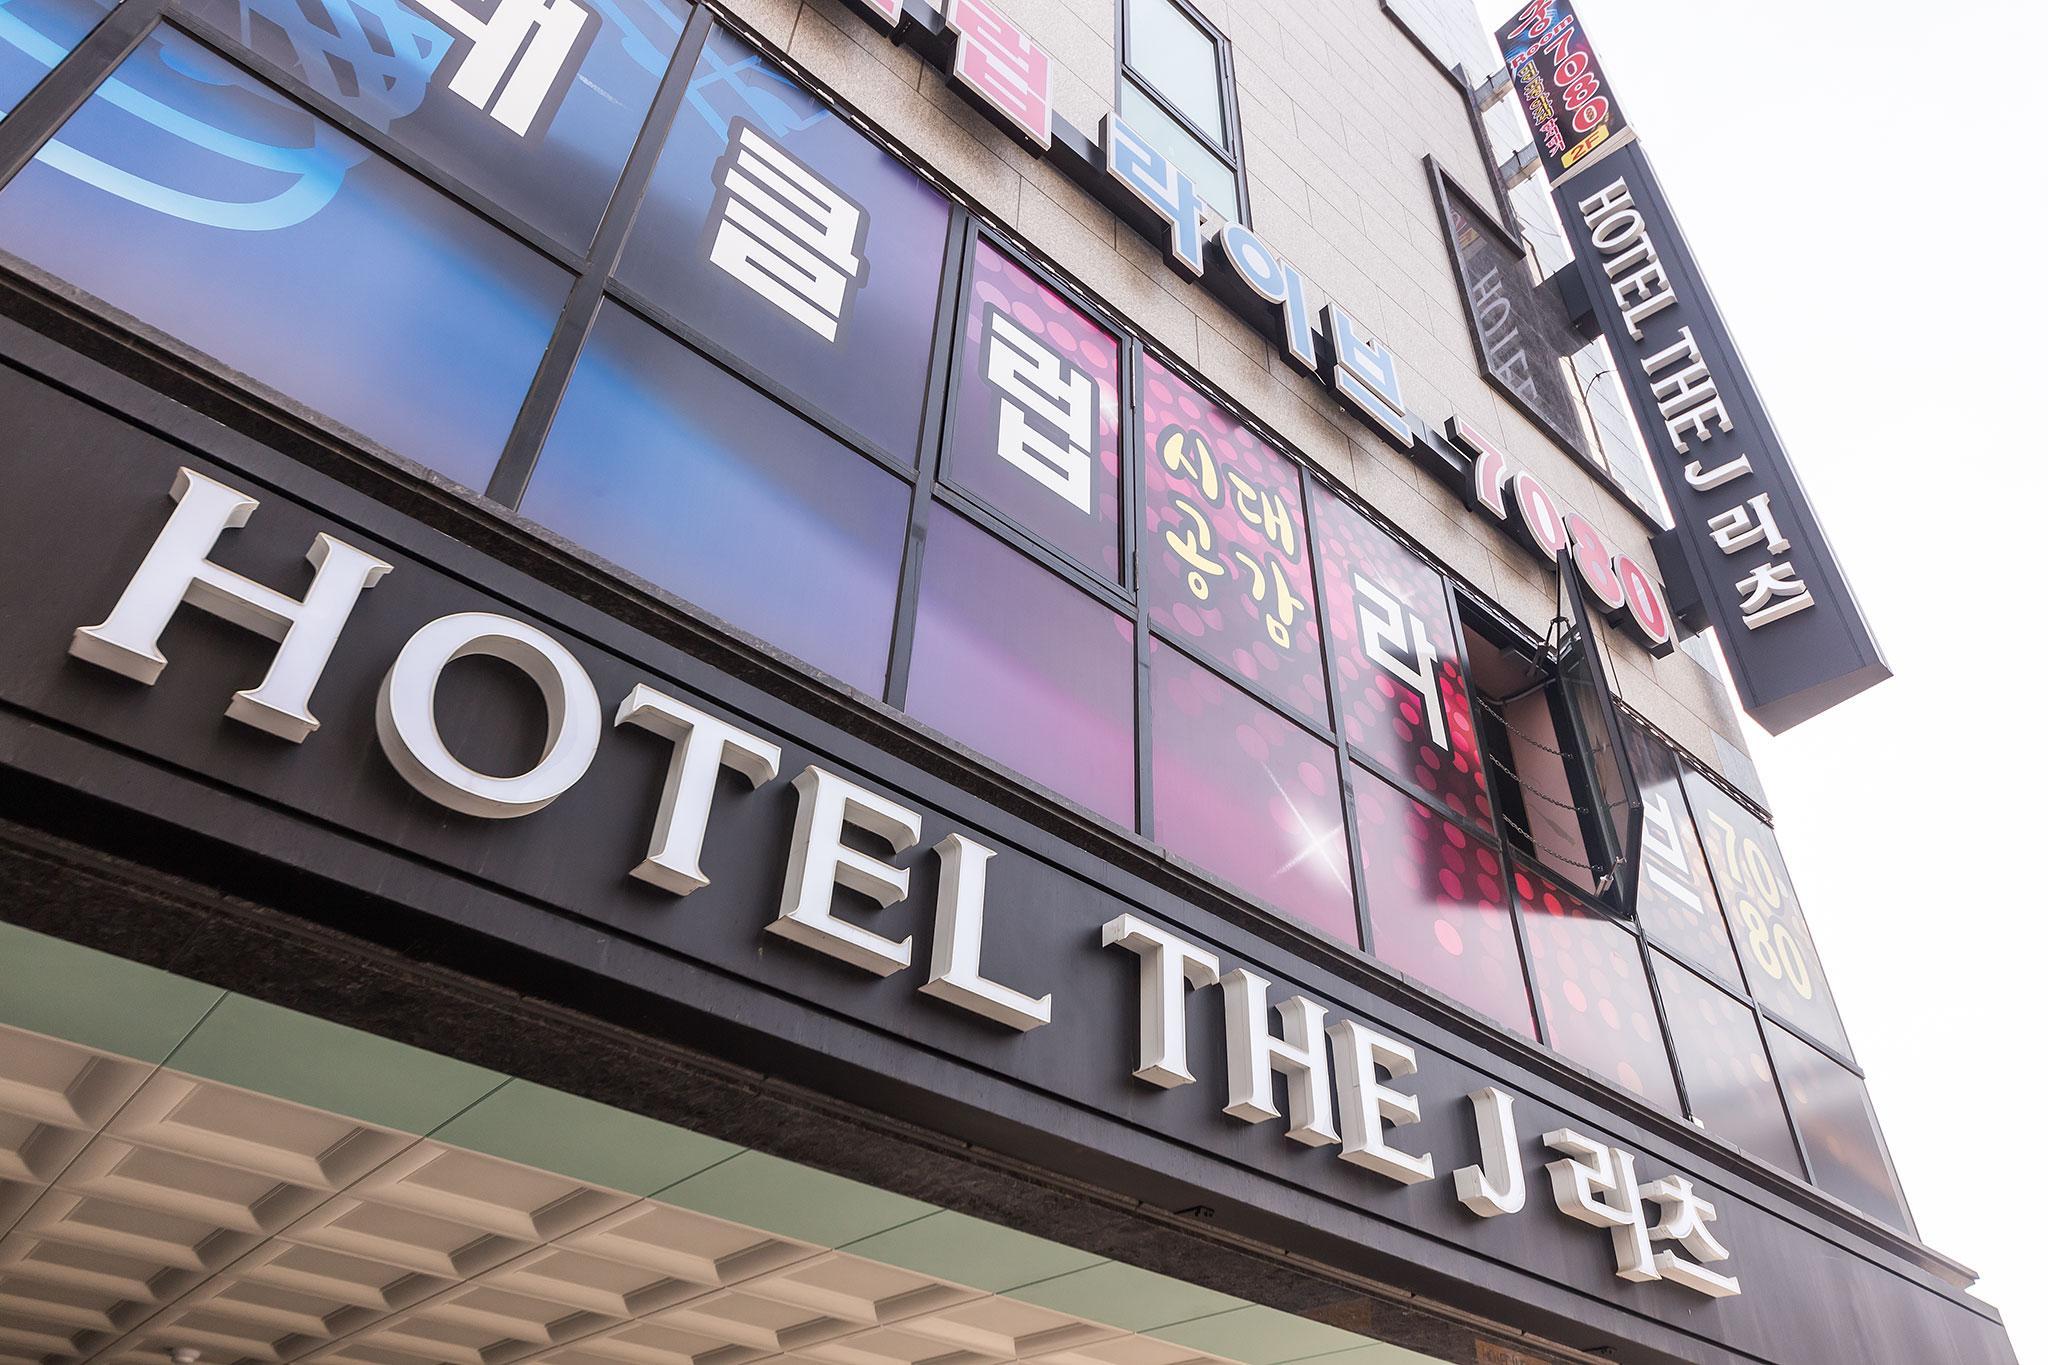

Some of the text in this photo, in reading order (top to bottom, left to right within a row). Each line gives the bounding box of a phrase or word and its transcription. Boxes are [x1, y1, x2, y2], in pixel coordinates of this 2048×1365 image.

[1511, 15, 1574, 69] Room
[1544, 27, 1609, 133] 7080
[1570, 131, 1601, 161] 2F
[1107, 111, 1413, 447] 라이브
[1578, 175, 1816, 630] HOTEL THE J 리츠
[1163, 430, 1295, 557] 시대
[1453, 413, 1670, 645] 7080
[1165, 508, 1304, 649] 공감
[68, 466, 1741, 1298] HOTEL THE J 리츠
[1707, 809, 1781, 909] 70
[1739, 899, 1813, 1000] 80
